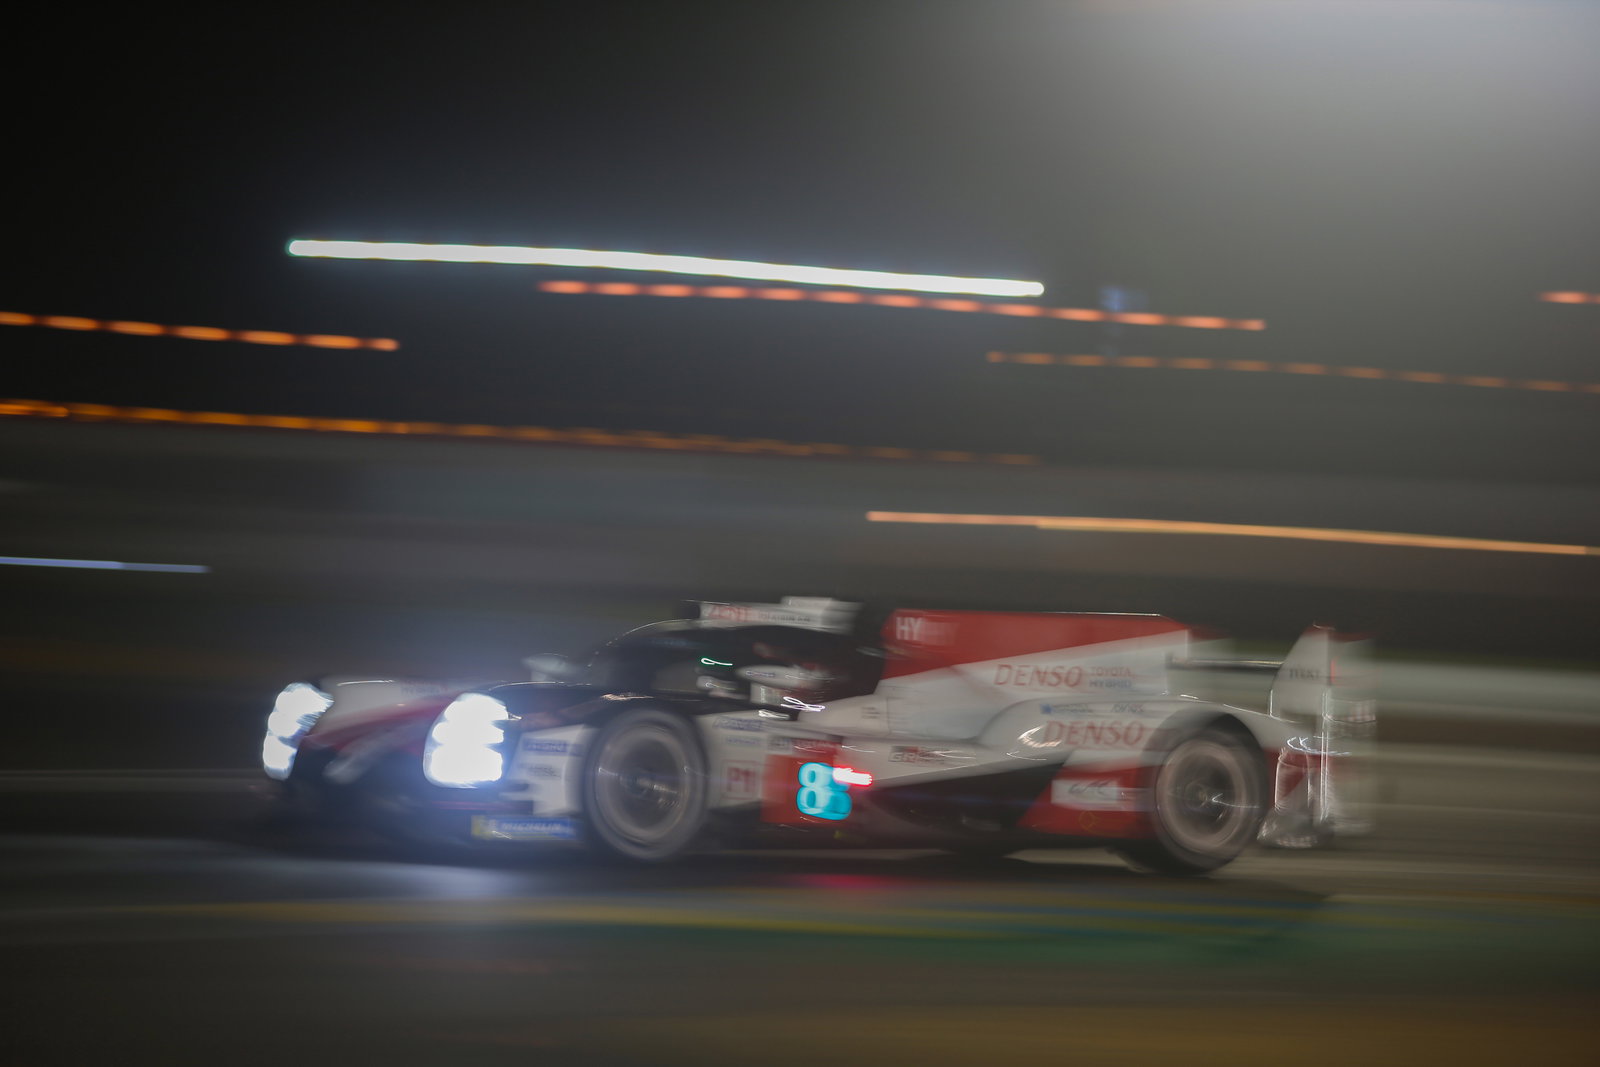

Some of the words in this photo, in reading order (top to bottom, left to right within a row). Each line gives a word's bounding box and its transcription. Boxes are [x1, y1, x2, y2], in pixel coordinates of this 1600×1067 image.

[993, 664, 1083, 688] DENSO
[1089, 666, 1134, 677] TOYOTA
[1043, 719, 1143, 747] DENSO
[797, 762, 852, 820] 8
